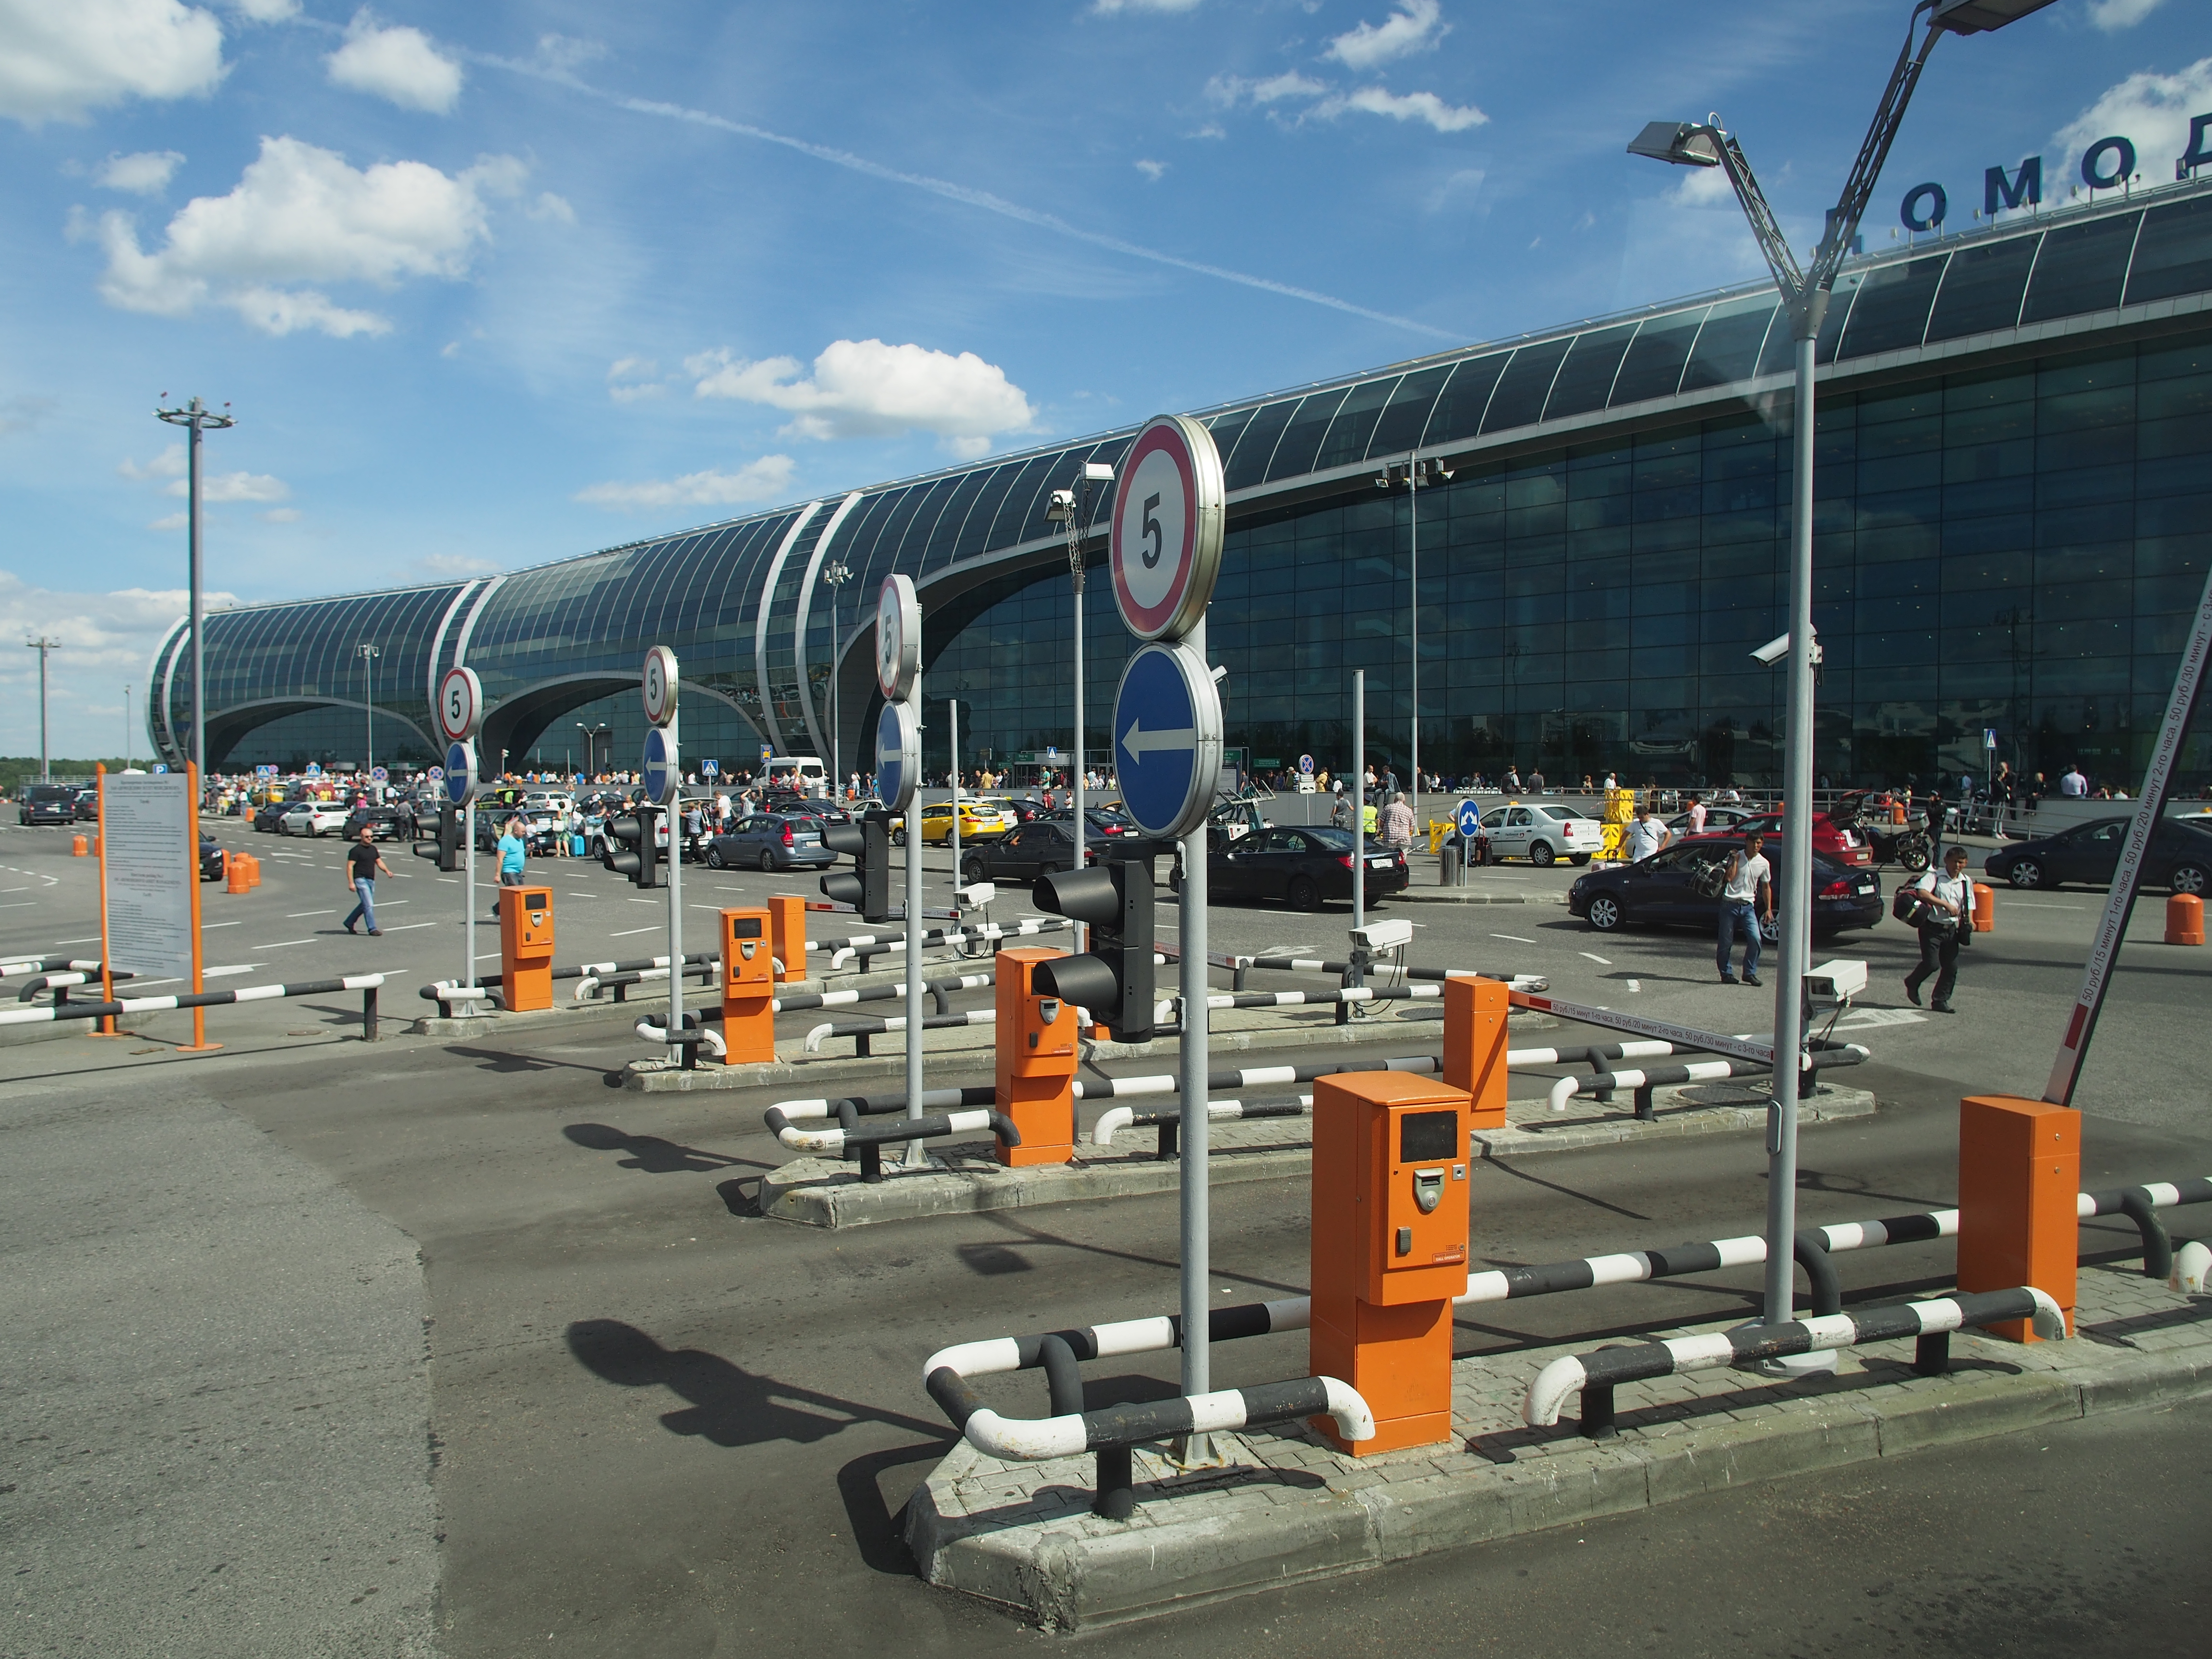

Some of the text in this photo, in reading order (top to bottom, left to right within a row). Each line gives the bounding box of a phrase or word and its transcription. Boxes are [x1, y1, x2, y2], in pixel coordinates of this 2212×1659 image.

[1142, 492, 1162, 569] 5
[885, 614, 891, 664] 5
[2189, 629, 2207, 663] минут
[650, 668, 657, 700] 5
[2177, 665, 2195, 705] руб./30
[452, 690, 460, 719] 5
[2169, 707, 2182, 721] 50
[2162, 726, 2179, 751] часа,
[156, 766, 164, 774] P
[2152, 754, 2167, 776] 2-го
[2144, 779, 2161, 810] минут
[2132, 812, 2149, 850] руб./20
[2125, 851, 2137, 865] 50
[2118, 869, 2134, 895] часа,
[2109, 897, 2123, 915] 1-го
[2101, 918, 2116, 949] минут
[2089, 950, 2106, 988] руб./15
[2082, 988, 2094, 1001] 50
[1553, 1003, 1559, 1011] 50
[1560, 1006, 1575, 1015] руб./15
[1576, 1010, 1590, 1019] минут
[1592, 1011, 1600, 1020] 1-го
[1601, 1015, 1614, 1024] часа,
[1615, 1016, 1622, 1024] 50
[1623, 1019, 1640, 1028] руб./20
[1642, 1023, 1657, 1033] минут
[1658, 1025, 1669, 1035] 2-го
[1670, 1029, 1684, 1039] часа,
[1685, 1031, 1692, 1040] 50
[1694, 1034, 1714, 1045] руб./30
[1715, 1039, 1732, 1050] минут
[1743, 1044, 1755, 1055] 3-го
[1756, 1048, 1770, 1058] часа
